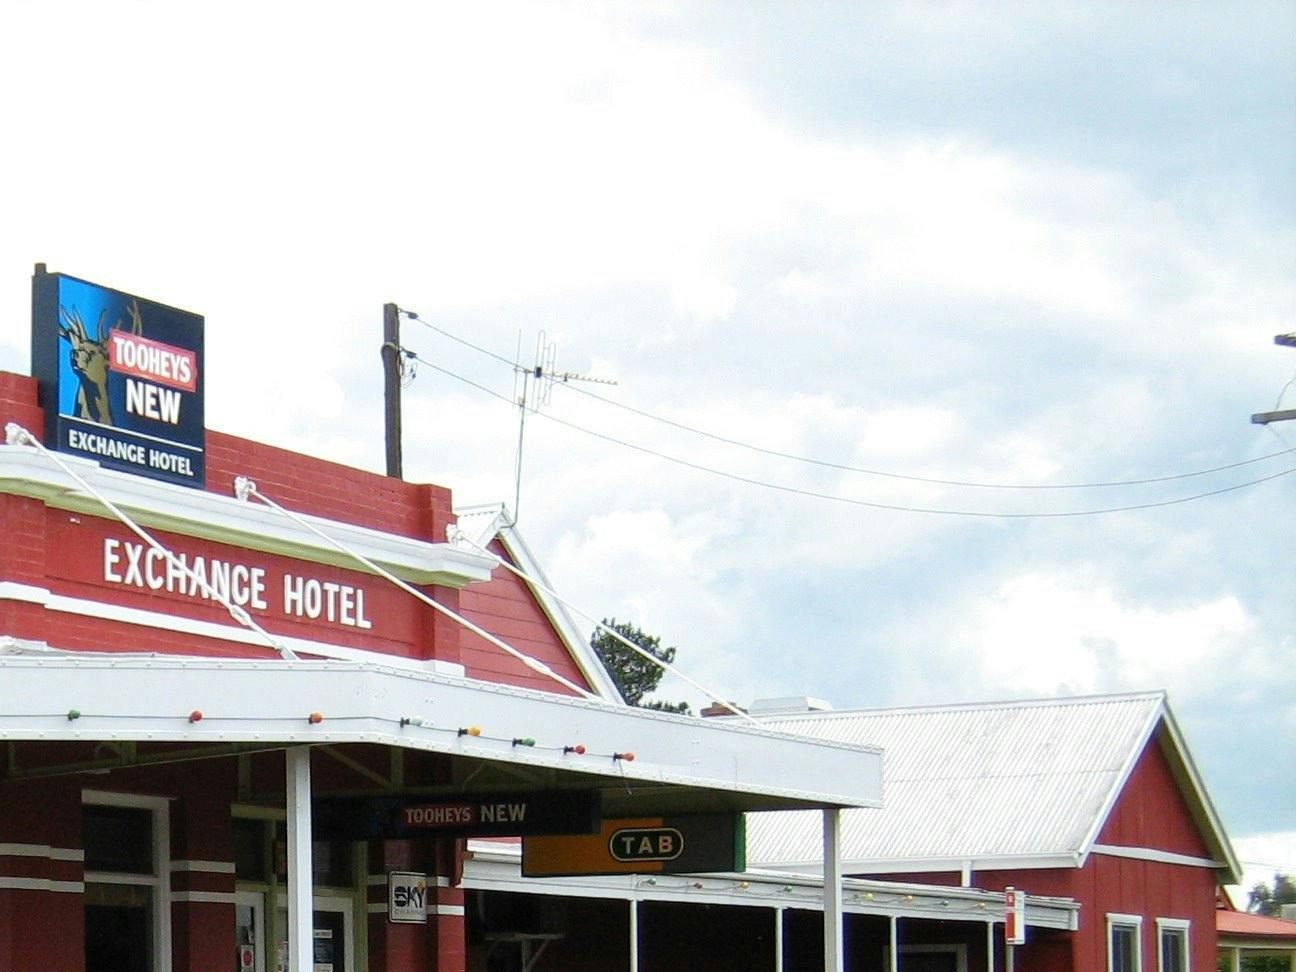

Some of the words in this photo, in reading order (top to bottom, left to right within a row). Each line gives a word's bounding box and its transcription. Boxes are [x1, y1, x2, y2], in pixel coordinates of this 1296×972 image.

[113, 336, 192, 383] TOOHEYS
[125, 379, 181, 424] NEW
[69, 430, 145, 463] EXCHANGE
[149, 450, 194, 476] HOTEL
[104, 538, 267, 609] EXCHANGE
[284, 574, 371, 629] HOTEL
[405, 806, 472, 825] TOOHEYS
[480, 803, 527, 823] NEW
[621, 836, 674, 855] TAB
[394, 885, 425, 909] SKY
